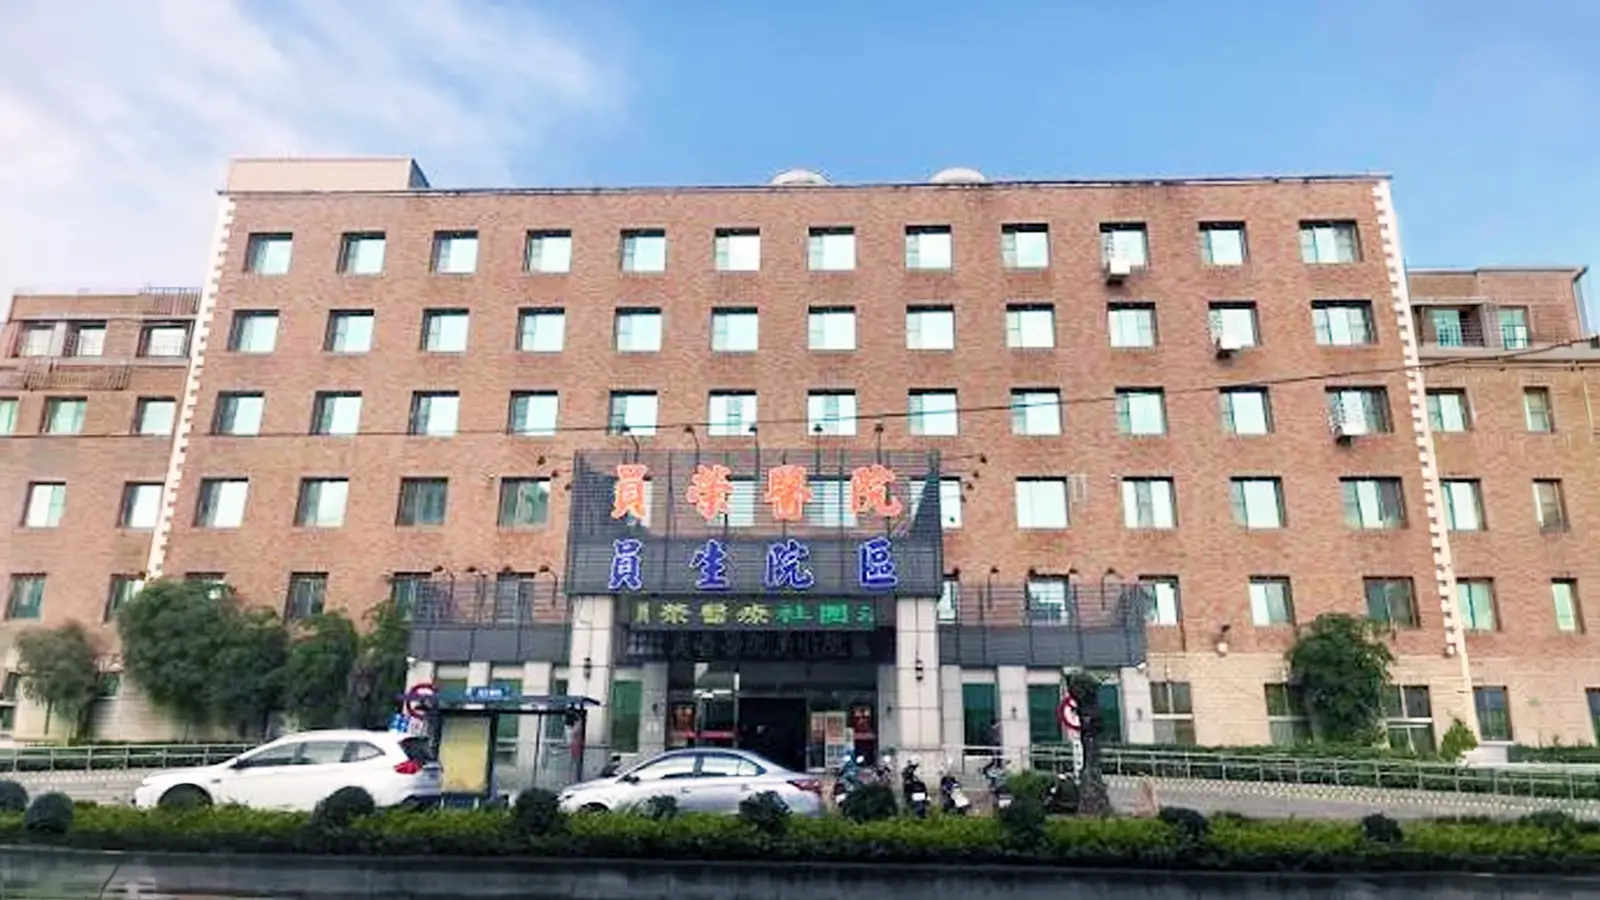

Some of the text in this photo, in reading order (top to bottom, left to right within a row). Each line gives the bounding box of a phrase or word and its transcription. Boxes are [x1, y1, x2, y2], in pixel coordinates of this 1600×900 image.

[611, 463, 901, 521] 員榮醫院
[608, 537, 897, 590] 員生院區
